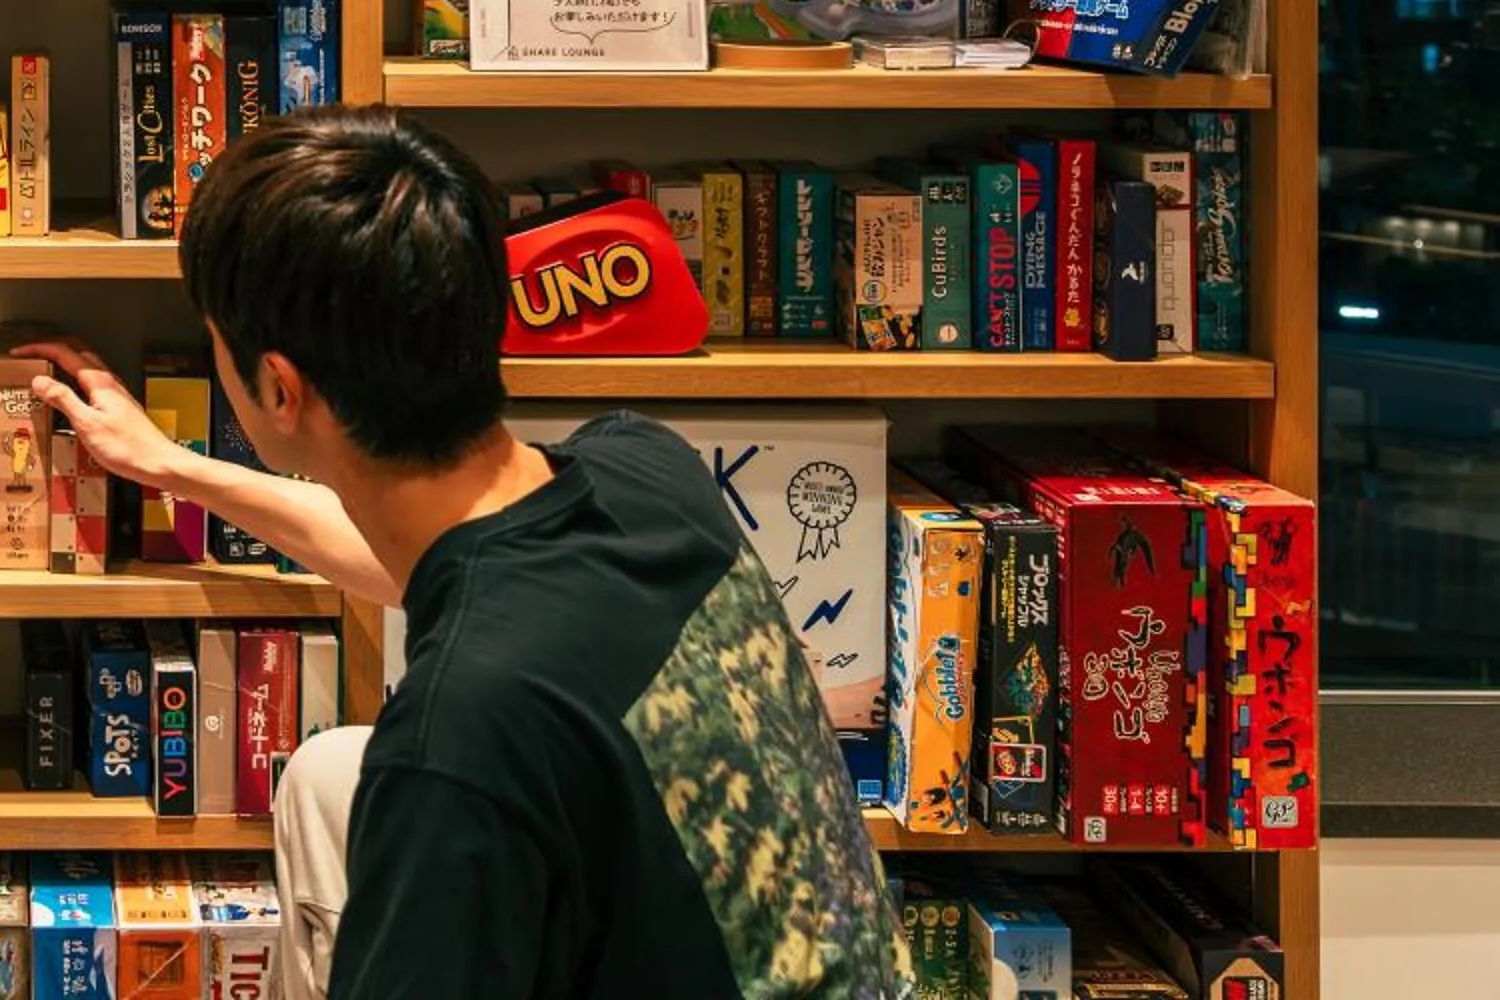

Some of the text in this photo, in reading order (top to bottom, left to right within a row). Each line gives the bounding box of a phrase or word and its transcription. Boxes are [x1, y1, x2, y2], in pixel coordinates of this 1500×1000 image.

[522, 47, 605, 57] SHARE LOUNGE
[190, 62, 213, 168] ッチワーク
[511, 245, 650, 327] UNO
[931, 225, 948, 298] CuBirds
[990, 227, 1016, 290] STOP
[1035, 212, 1047, 289] MESSAGE
[1029, 554, 1049, 626] ブロックス
[39, 696, 53, 767] FIXER
[163, 687, 188, 799] YUBIBO
